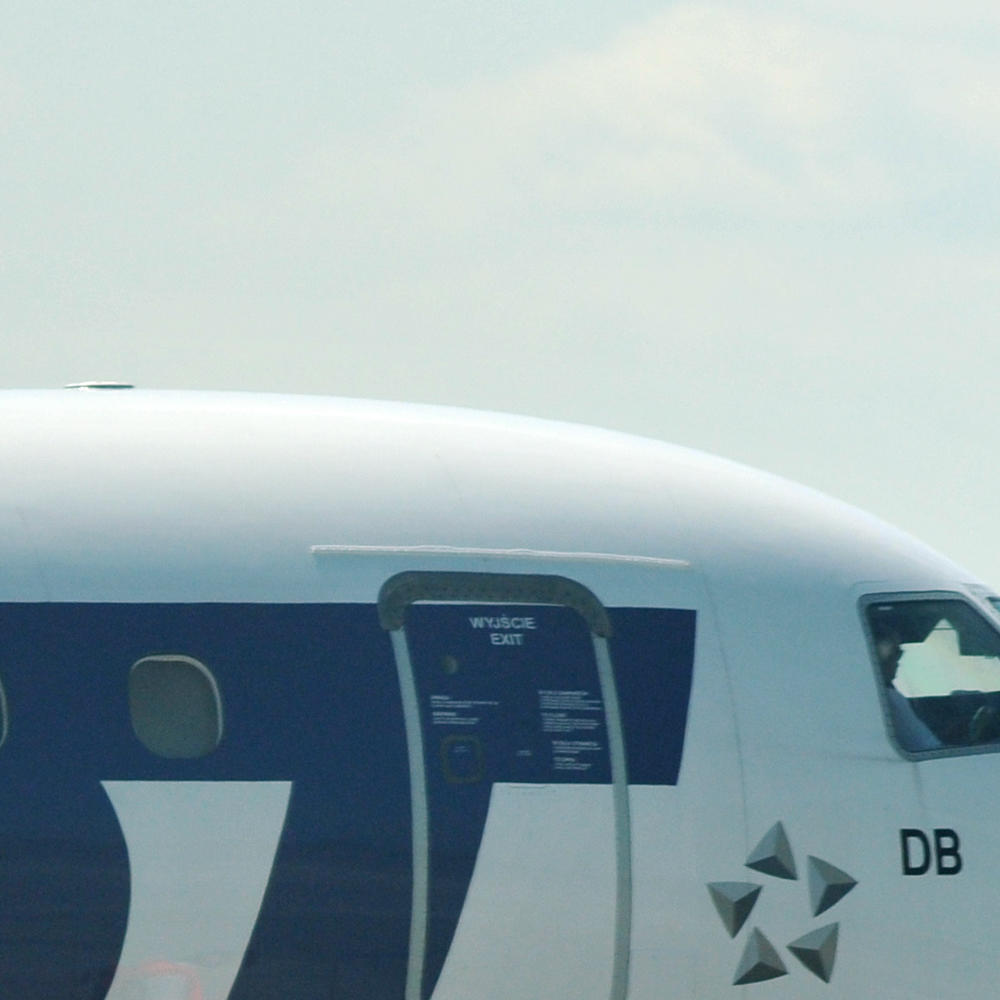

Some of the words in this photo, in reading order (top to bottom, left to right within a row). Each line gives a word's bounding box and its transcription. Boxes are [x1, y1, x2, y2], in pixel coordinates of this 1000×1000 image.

[469, 613, 537, 630] WYJŚCIE
[489, 633, 525, 646] EXIT
[900, 828, 963, 876] DB
